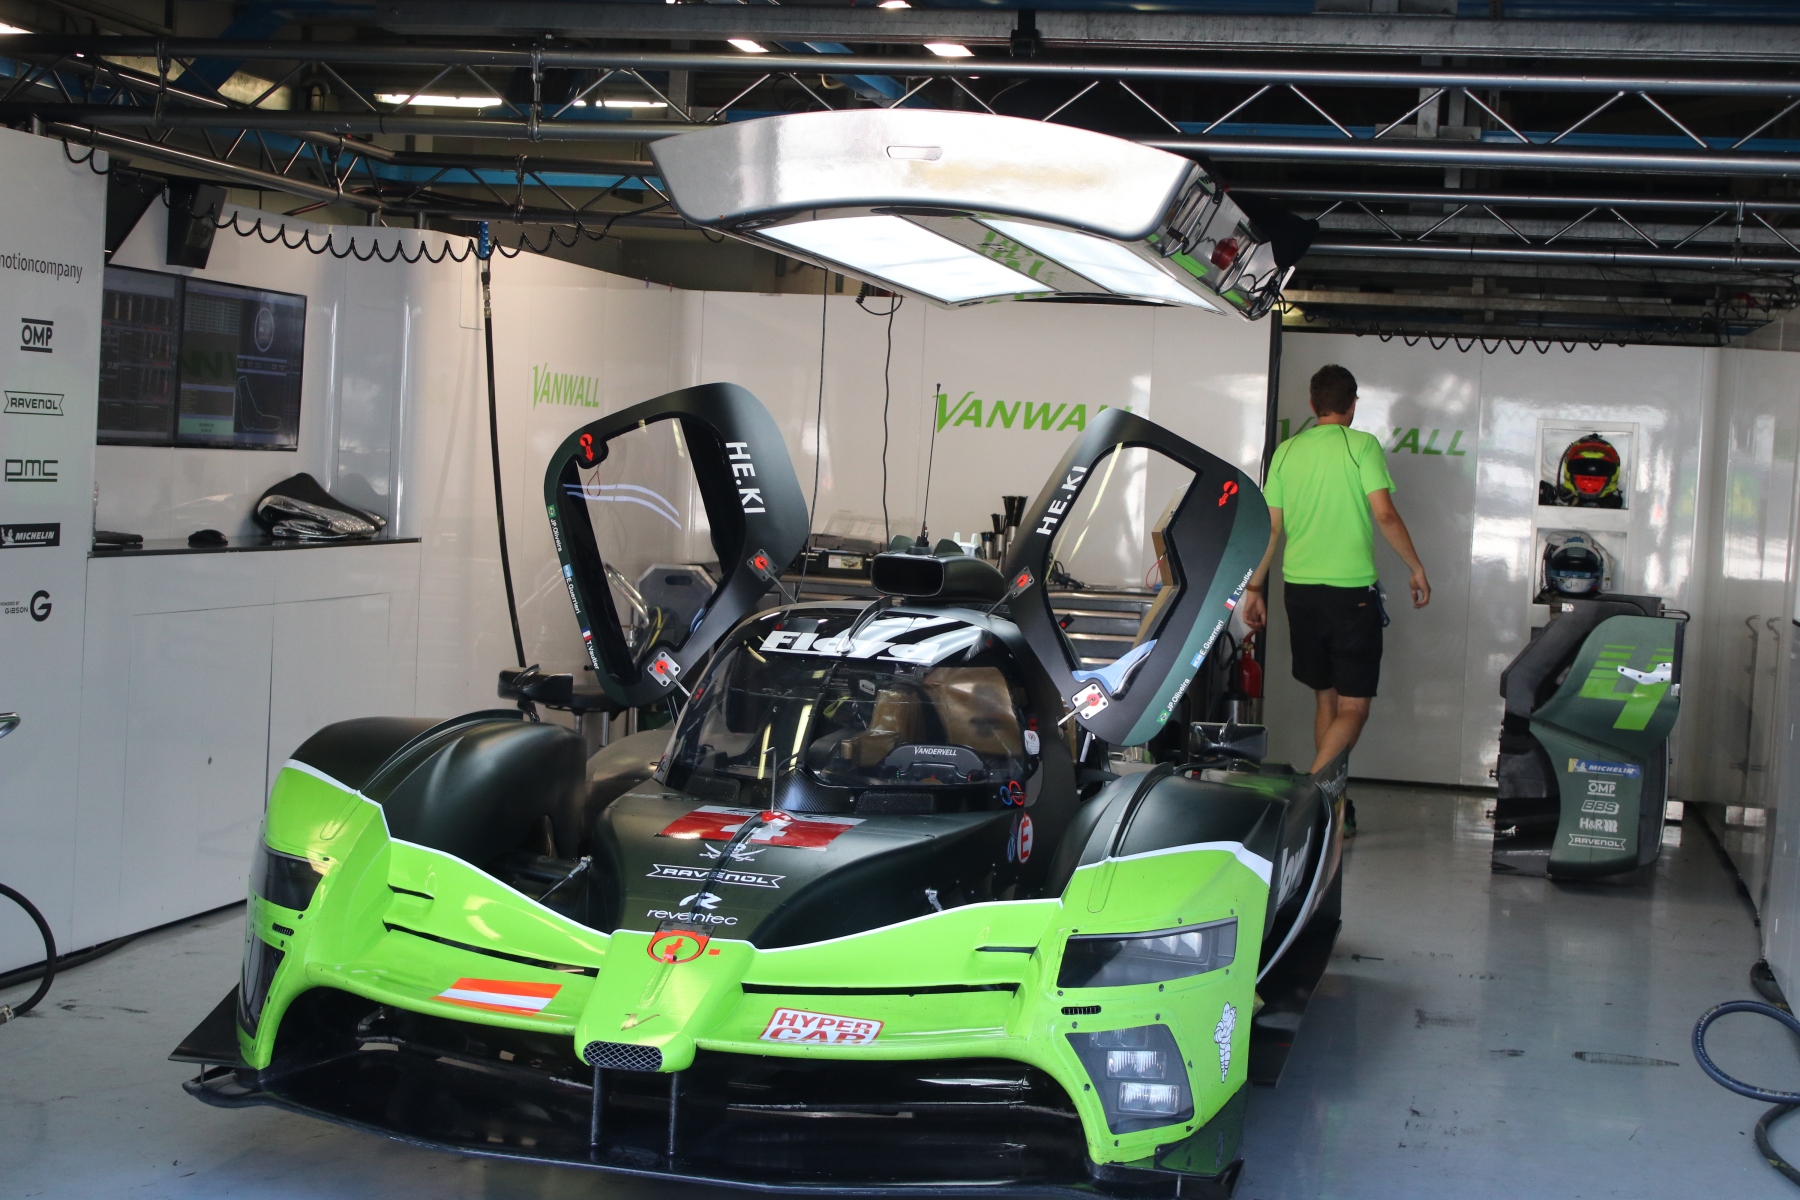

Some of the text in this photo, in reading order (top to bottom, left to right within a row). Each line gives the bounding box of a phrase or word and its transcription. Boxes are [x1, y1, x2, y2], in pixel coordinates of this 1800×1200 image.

[21, 324, 53, 347] OMP
[532, 362, 600, 411] VANWALL
[10, 397, 59, 410] RAVENOL
[932, 391, 1133, 433] VANWA
[725, 441, 766, 514] HE.KI
[1036, 465, 1088, 536] HE.KI
[15, 530, 55, 541] MICHELIN
[914, 746, 957, 756] VANDERVELL
[1588, 764, 1635, 775] MICHELIN
[1588, 782, 1616, 794] OMP
[1581, 800, 1620, 815] BBS
[1574, 836, 1620, 848] RAVENOL
[662, 867, 769, 885] RAVENOL
[646, 908, 739, 926] reventec
[776, 1012, 873, 1034] HYPER
